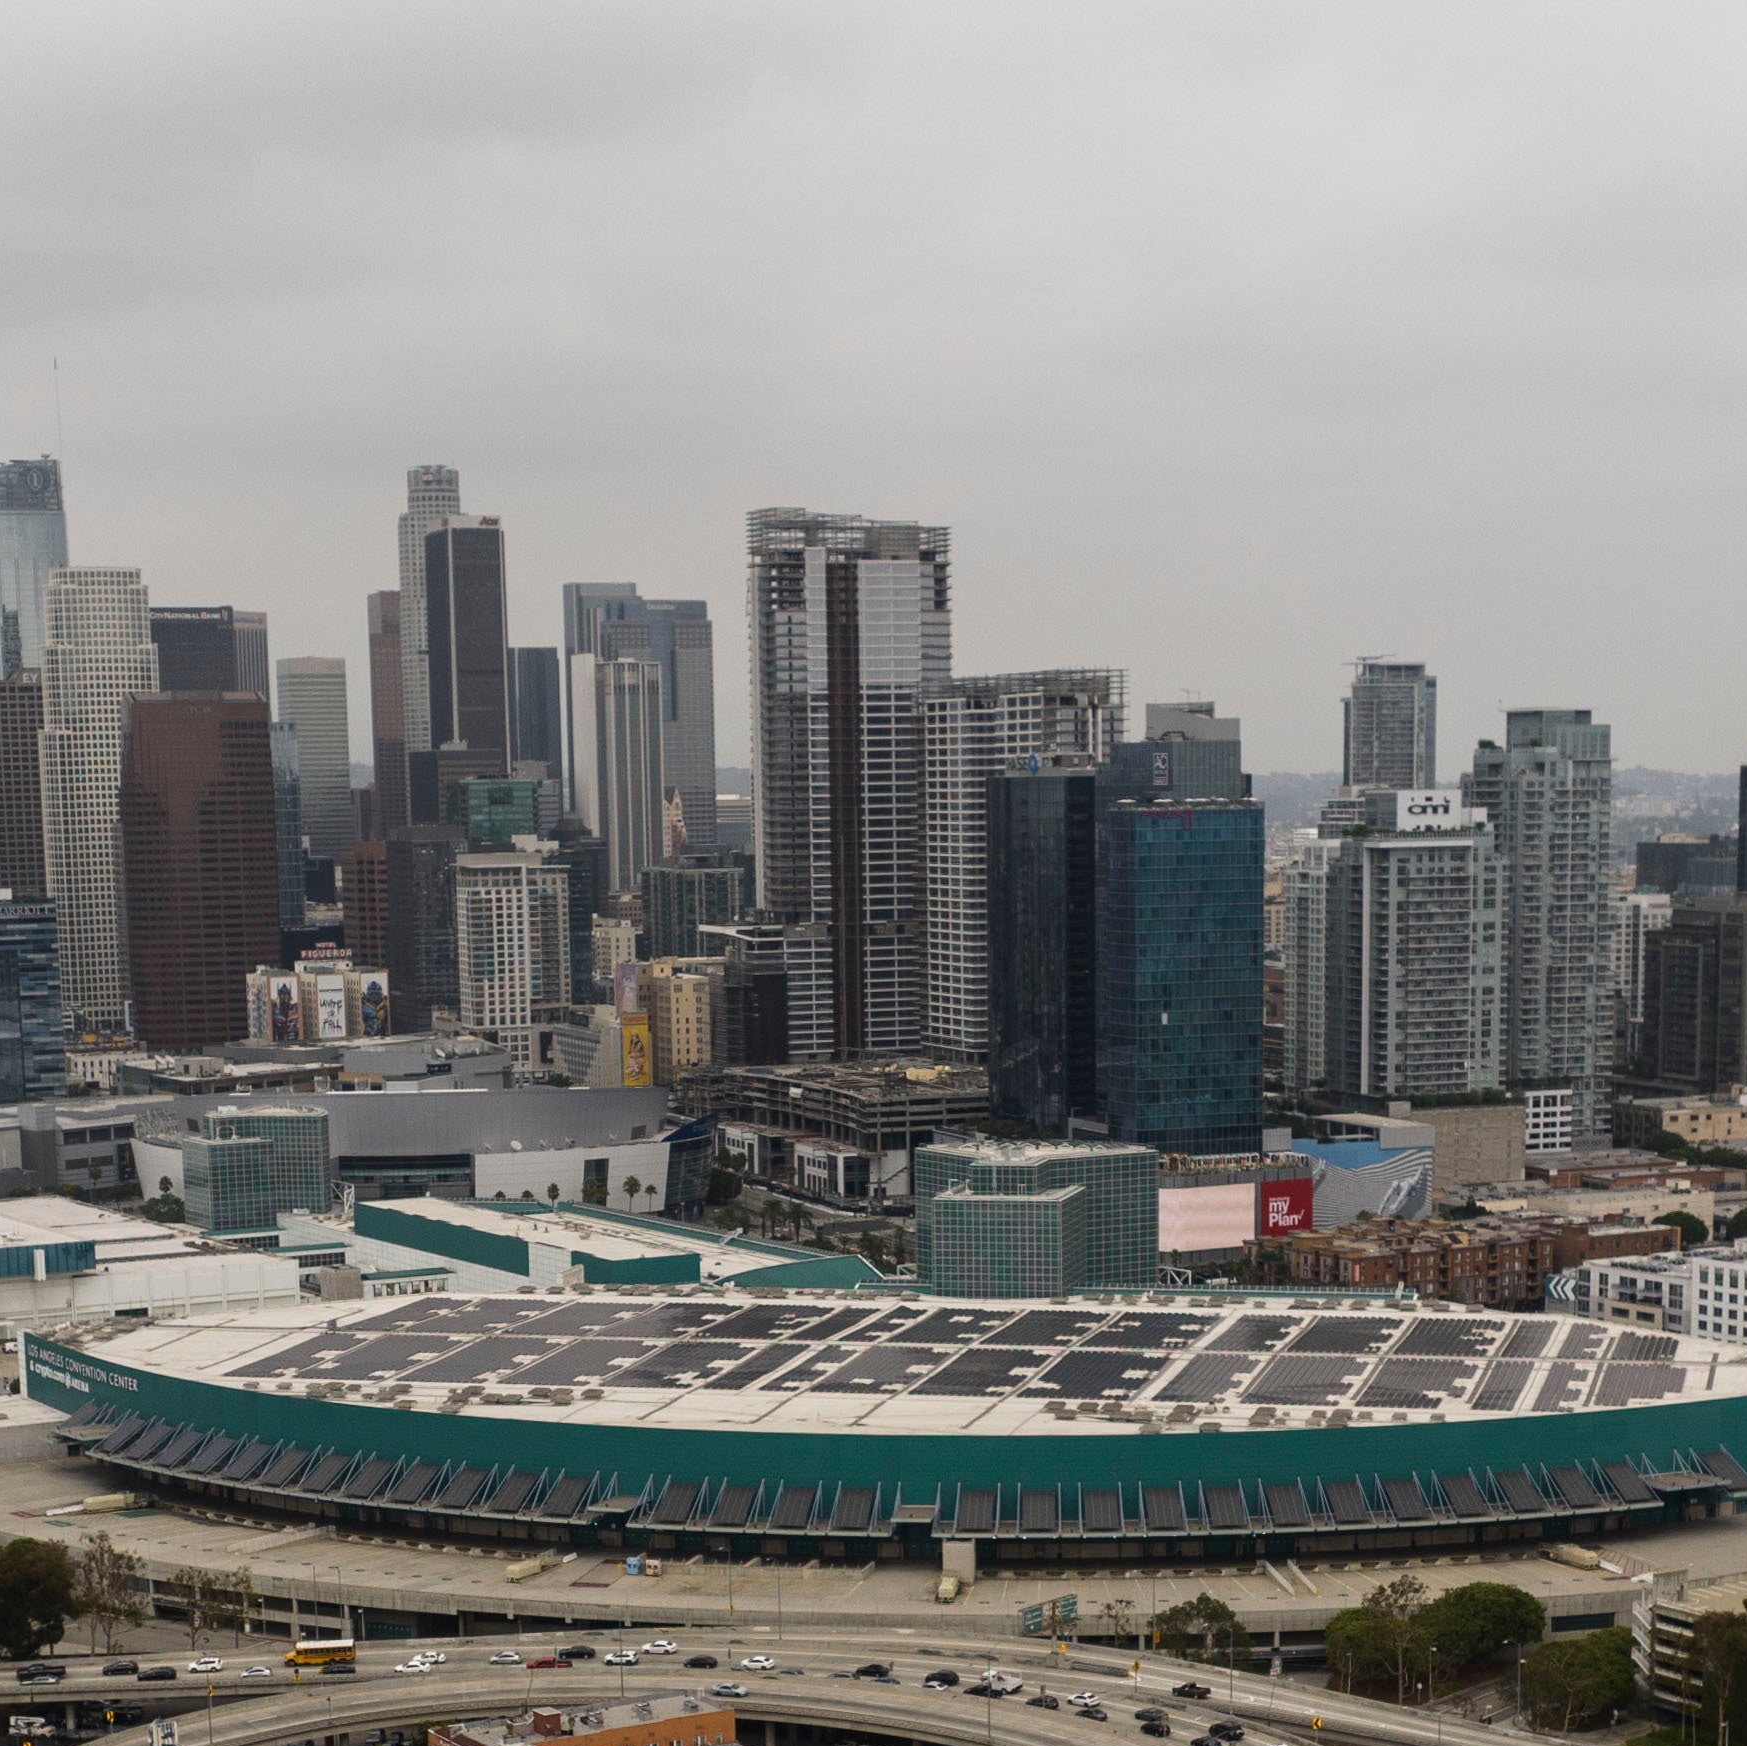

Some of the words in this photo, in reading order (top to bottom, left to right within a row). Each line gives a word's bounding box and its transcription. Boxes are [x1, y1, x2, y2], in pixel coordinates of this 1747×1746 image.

[22, 674, 37, 684] EY
[301, 949, 352, 959] FIGUEROA
[1269, 1197, 1291, 1214] my
[1269, 1212, 1300, 1228] Plan
[65, 1357, 107, 1385] CONVENTION
[108, 1371, 139, 1393] CENTER
